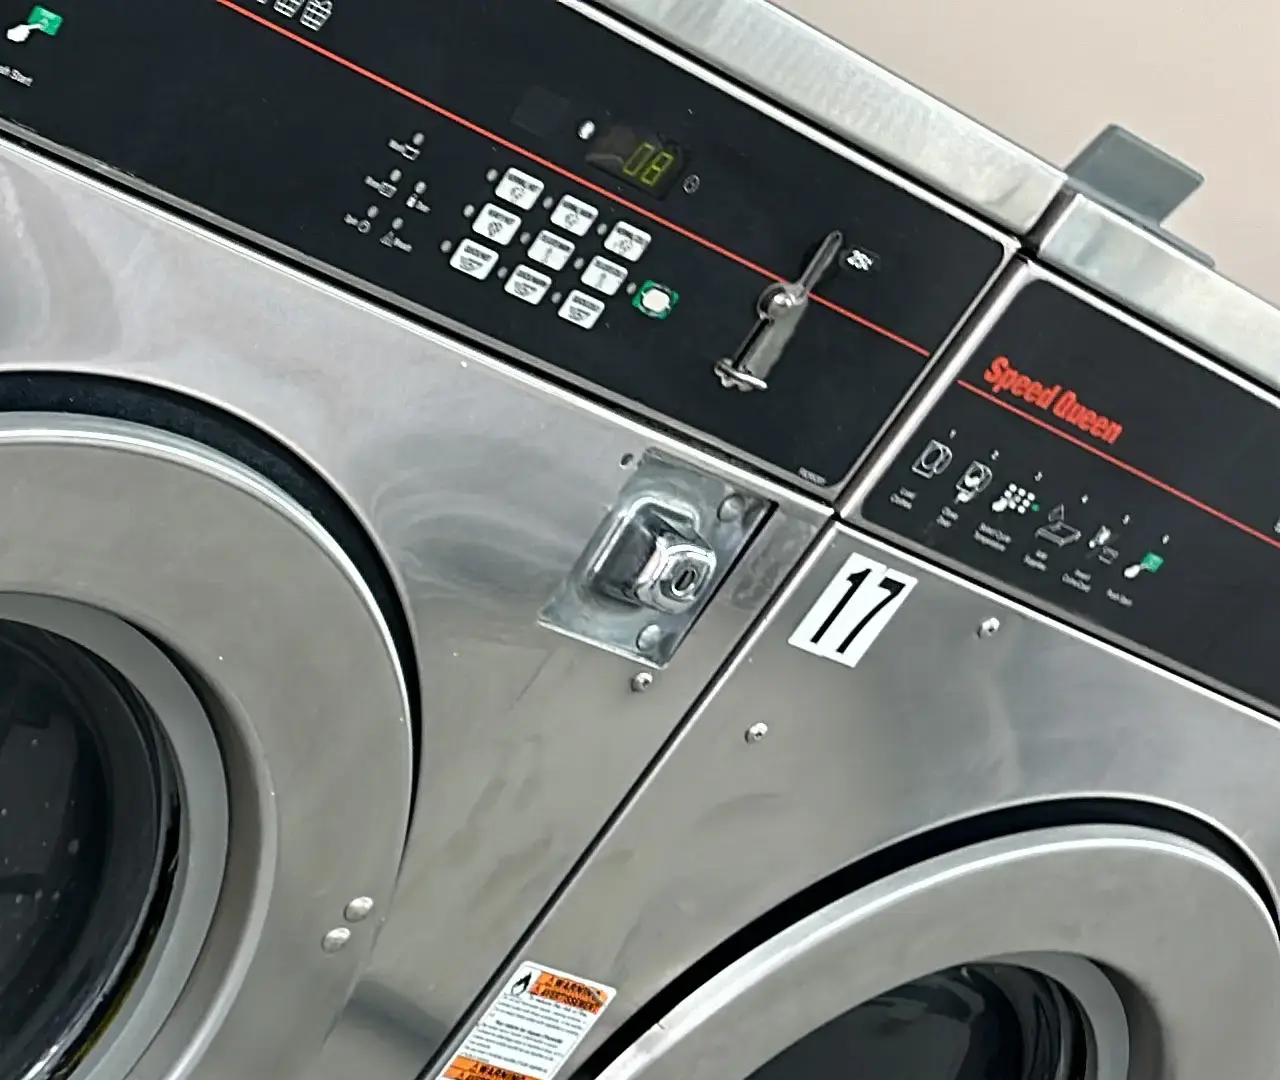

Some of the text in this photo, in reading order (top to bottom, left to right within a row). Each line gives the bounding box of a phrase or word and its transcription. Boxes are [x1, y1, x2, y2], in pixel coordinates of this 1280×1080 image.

[623, 142, 674, 186] 08
[983, 355, 1123, 445] Speed Queen
[811, 568, 906, 654] 17
